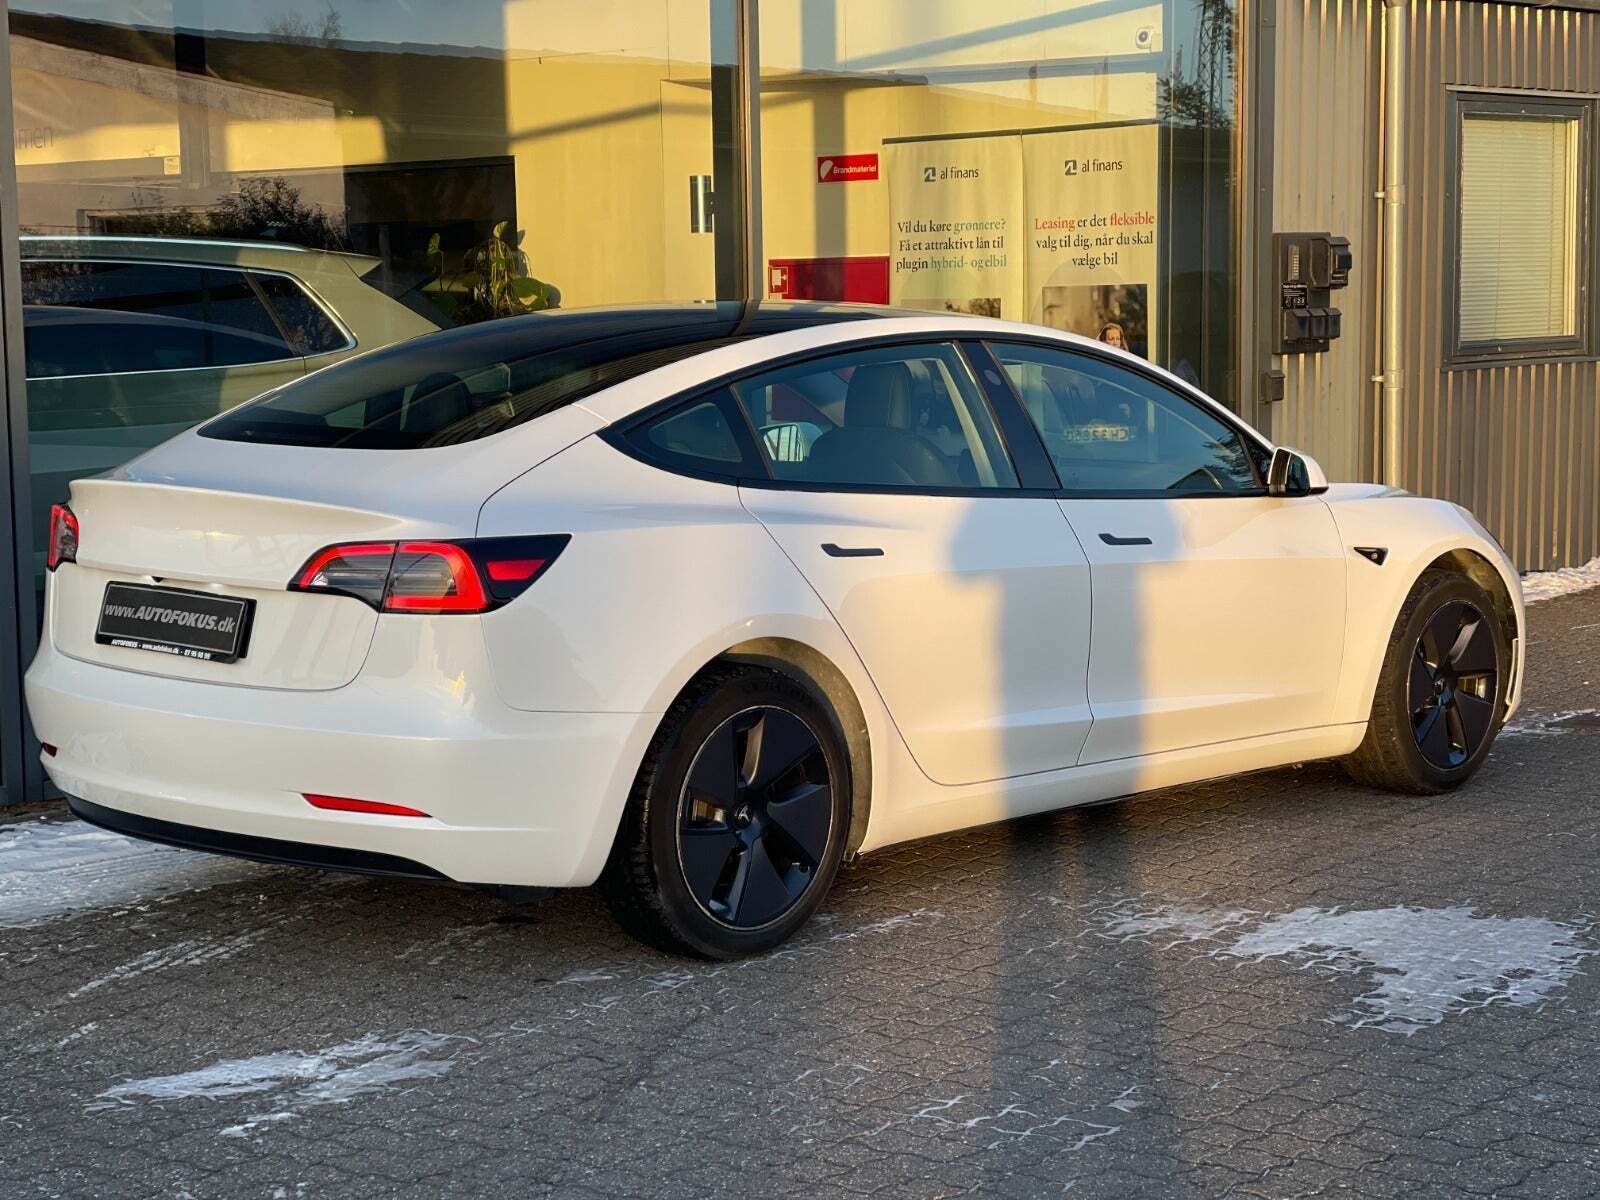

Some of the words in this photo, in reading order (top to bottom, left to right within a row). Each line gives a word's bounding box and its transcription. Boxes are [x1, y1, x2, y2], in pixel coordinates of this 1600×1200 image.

[833, 163, 877, 174] Brandmateriel
[940, 167, 948, 180] al
[950, 166, 980, 179] finans
[1081, 160, 1090, 173] al
[1092, 159, 1123, 172] finans
[898, 221, 912, 233] Vil
[913, 220, 927, 233] du
[1035, 217, 1076, 232] Leasing
[1077, 219, 1088, 227] er
[1089, 214, 1107, 227] det
[1110, 211, 1155, 226] fleksible
[899, 239, 911, 252] Få
[912, 242, 922, 251] et
[924, 237, 974, 251] attraktivt
[992, 235, 1004, 249] til
[1036, 235, 1058, 252] valg
[1059, 234, 1071, 247] til
[1073, 234, 1093, 250] dig,
[1116, 232, 1130, 245] du
[1131, 230, 1153, 244] skal
[896, 256, 928, 273] plugin
[970, 258, 984, 272] og
[984, 254, 1007, 268] elbil
[1072, 252, 1101, 270] vælge
[1103, 251, 1118, 265] bil
[104, 604, 236, 633] www.AUTOFOKUS.dk
